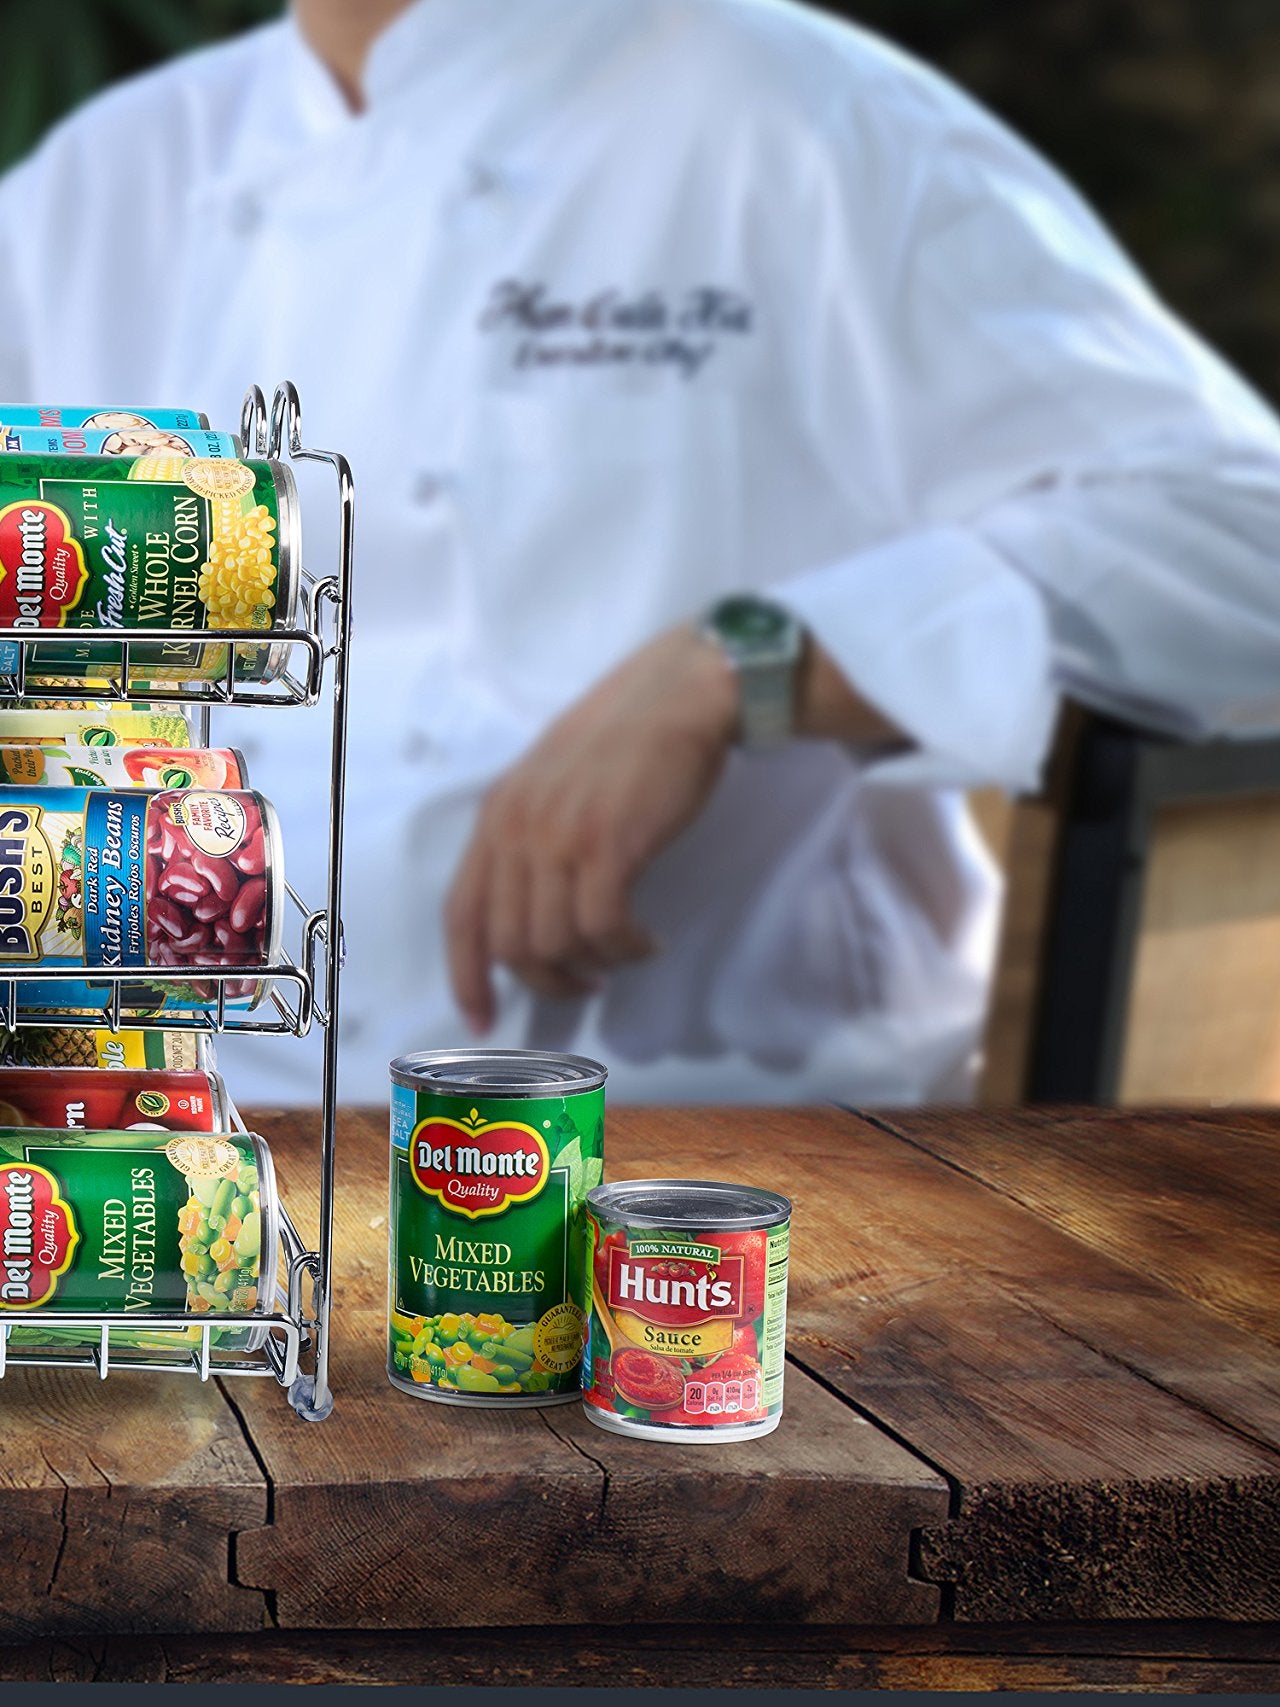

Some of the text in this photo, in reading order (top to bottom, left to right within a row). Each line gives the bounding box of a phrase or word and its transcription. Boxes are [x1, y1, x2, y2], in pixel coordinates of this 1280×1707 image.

[82, 487, 98, 539] WITH
[16, 509, 46, 593] Monte
[50, 547, 70, 601] Quality
[97, 518, 128, 628] Fresh Cut
[129, 549, 140, 604] Golden Sweet
[138, 532, 170, 621] WHOLE
[161, 496, 199, 656] KRNEL CORN
[1, 645, 15, 672] SALT
[190, 803, 200, 826] FAMILY
[200, 801, 213, 831] FAVORITE
[208, 797, 235, 841] Recipes
[31, 847, 43, 913] BEST
[86, 847, 99, 914] Dark Red
[101, 801, 127, 967] Kidney Beans
[128, 814, 142, 954] Frijoles Rojos Oscuros
[417, 1141, 540, 1177] Del Monte
[447, 1179, 500, 1201] Quality
[0, 1171, 35, 1299] Del Monte
[38, 1209, 60, 1265] Quality
[98, 1199, 126, 1280] MIXED
[124, 1167, 156, 1312] VEGETABLES
[434, 1234, 512, 1265] MIXED
[635, 1244, 714, 1259] 100% NATURAL
[409, 1255, 545, 1293] VEGETABLES
[620, 1263, 732, 1311] Hunt's
[541, 1353, 563, 1371] GREAT
[644, 1326, 702, 1346] Sauce
[650, 1344, 665, 1352] Salsa
[690, 1387, 702, 1400] 20
